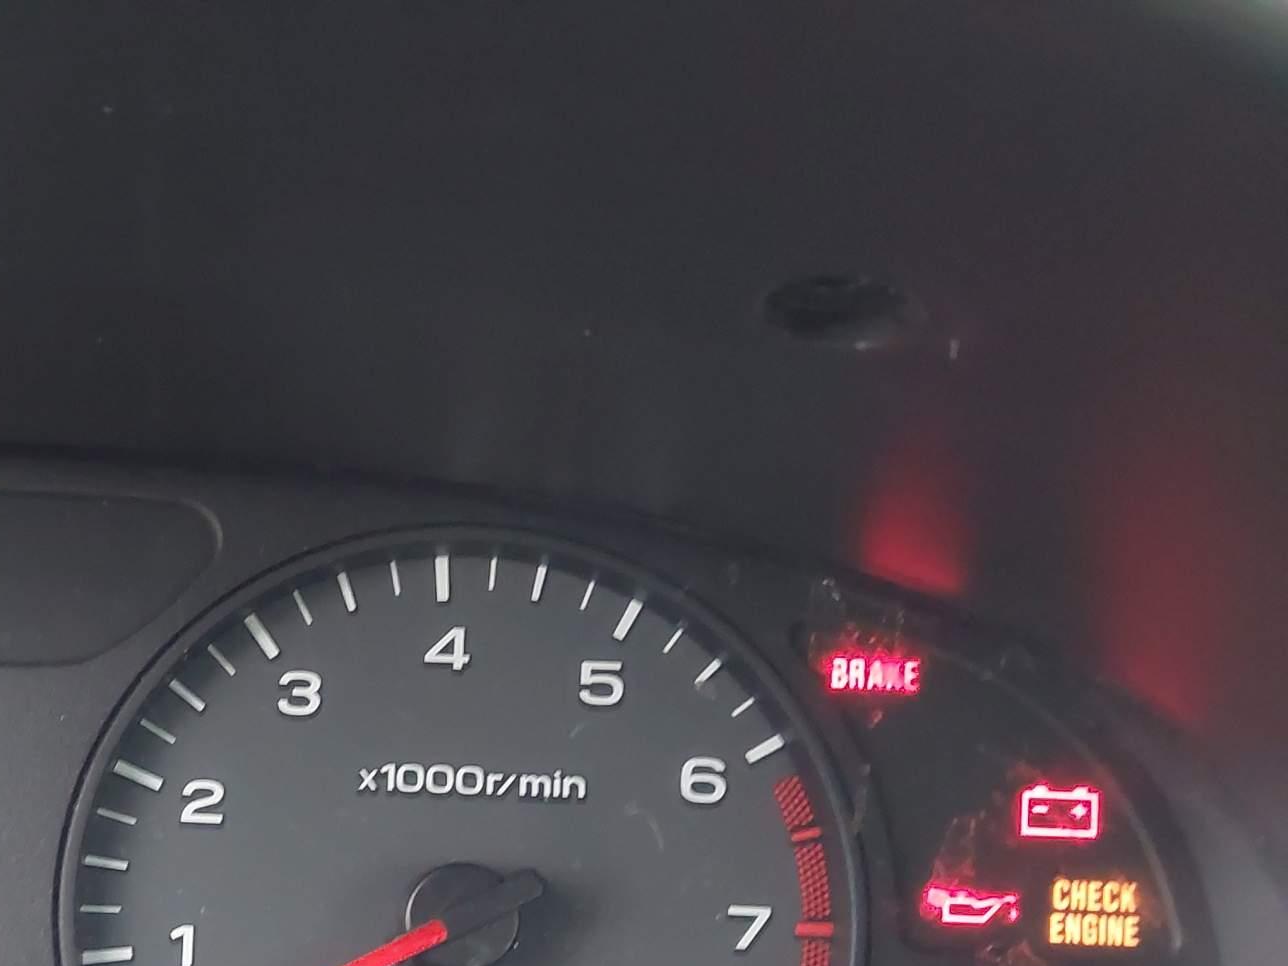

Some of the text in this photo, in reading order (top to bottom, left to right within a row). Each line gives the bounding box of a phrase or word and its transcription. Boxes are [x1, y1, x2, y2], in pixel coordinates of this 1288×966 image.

[423, 626, 472, 671] 4
[277, 670, 323, 717] 3
[578, 660, 625, 706] 5
[829, 656, 922, 692] BRAKE
[179, 778, 226, 826] 2
[357, 763, 588, 800] x1000r/min
[679, 756, 727, 805] 6
[1051, 877, 1139, 914] CHECK
[726, 904, 773, 951] 7
[1049, 913, 1141, 948] ENGINE
